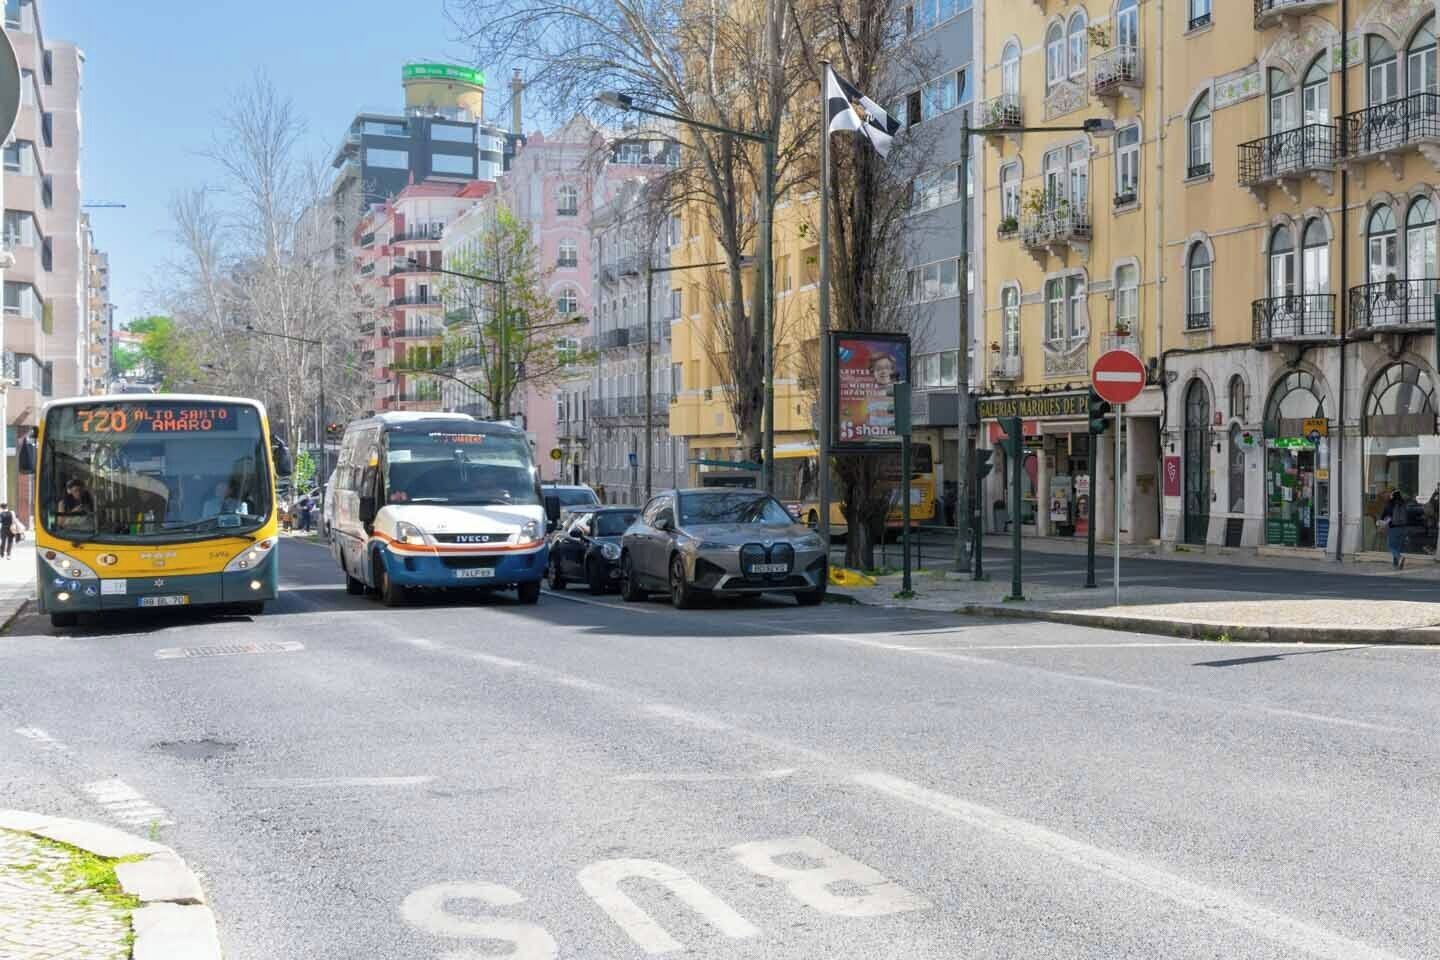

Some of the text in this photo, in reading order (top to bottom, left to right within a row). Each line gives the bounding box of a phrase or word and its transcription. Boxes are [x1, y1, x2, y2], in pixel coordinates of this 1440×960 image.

[179, 409, 228, 420] SANTO
[980, 400, 1017, 417] GALERIAS
[1020, 397, 1060, 416] MARQUES
[1063, 396, 1075, 414] DE
[77, 410, 128, 433] 720
[151, 419, 213, 432] AMARO
[400, 838, 936, 960] BUS
